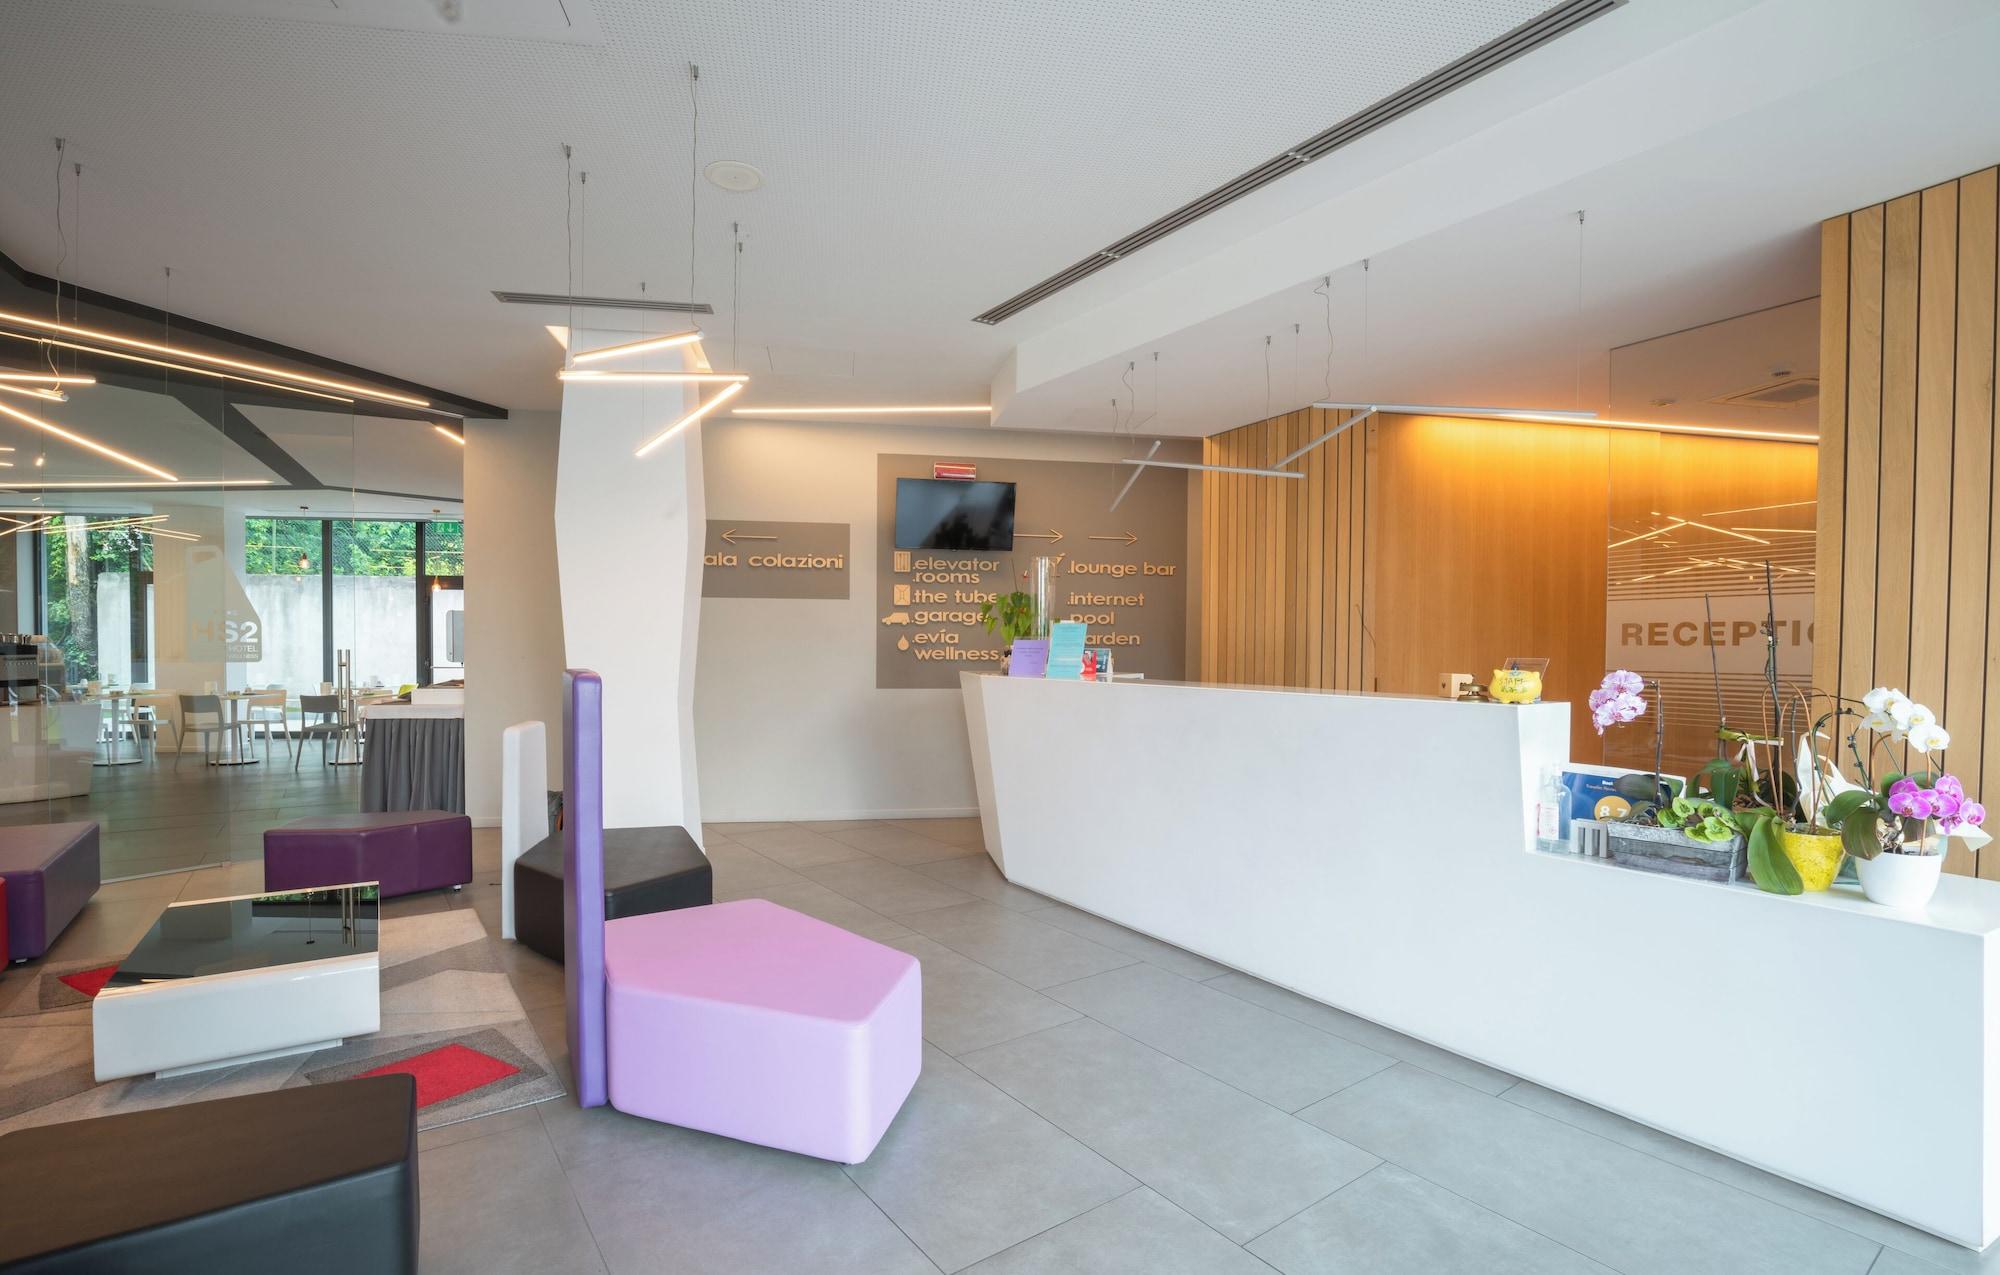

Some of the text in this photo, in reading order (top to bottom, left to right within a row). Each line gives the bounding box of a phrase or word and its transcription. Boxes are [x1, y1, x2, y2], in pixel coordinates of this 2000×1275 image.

[704, 552, 844, 569] ala colazioni
[912, 556, 1000, 572] .elevator
[1067, 560, 1176, 578] .lounge bar
[912, 572, 980, 584] .rooms
[912, 589, 997, 604] .the tube
[1067, 592, 1145, 606] .internet
[192, 620, 258, 643] HS2
[1085, 632, 1140, 645] arden
[1621, 619, 1814, 647] RECEPTI
[914, 647, 999, 661] wellness
